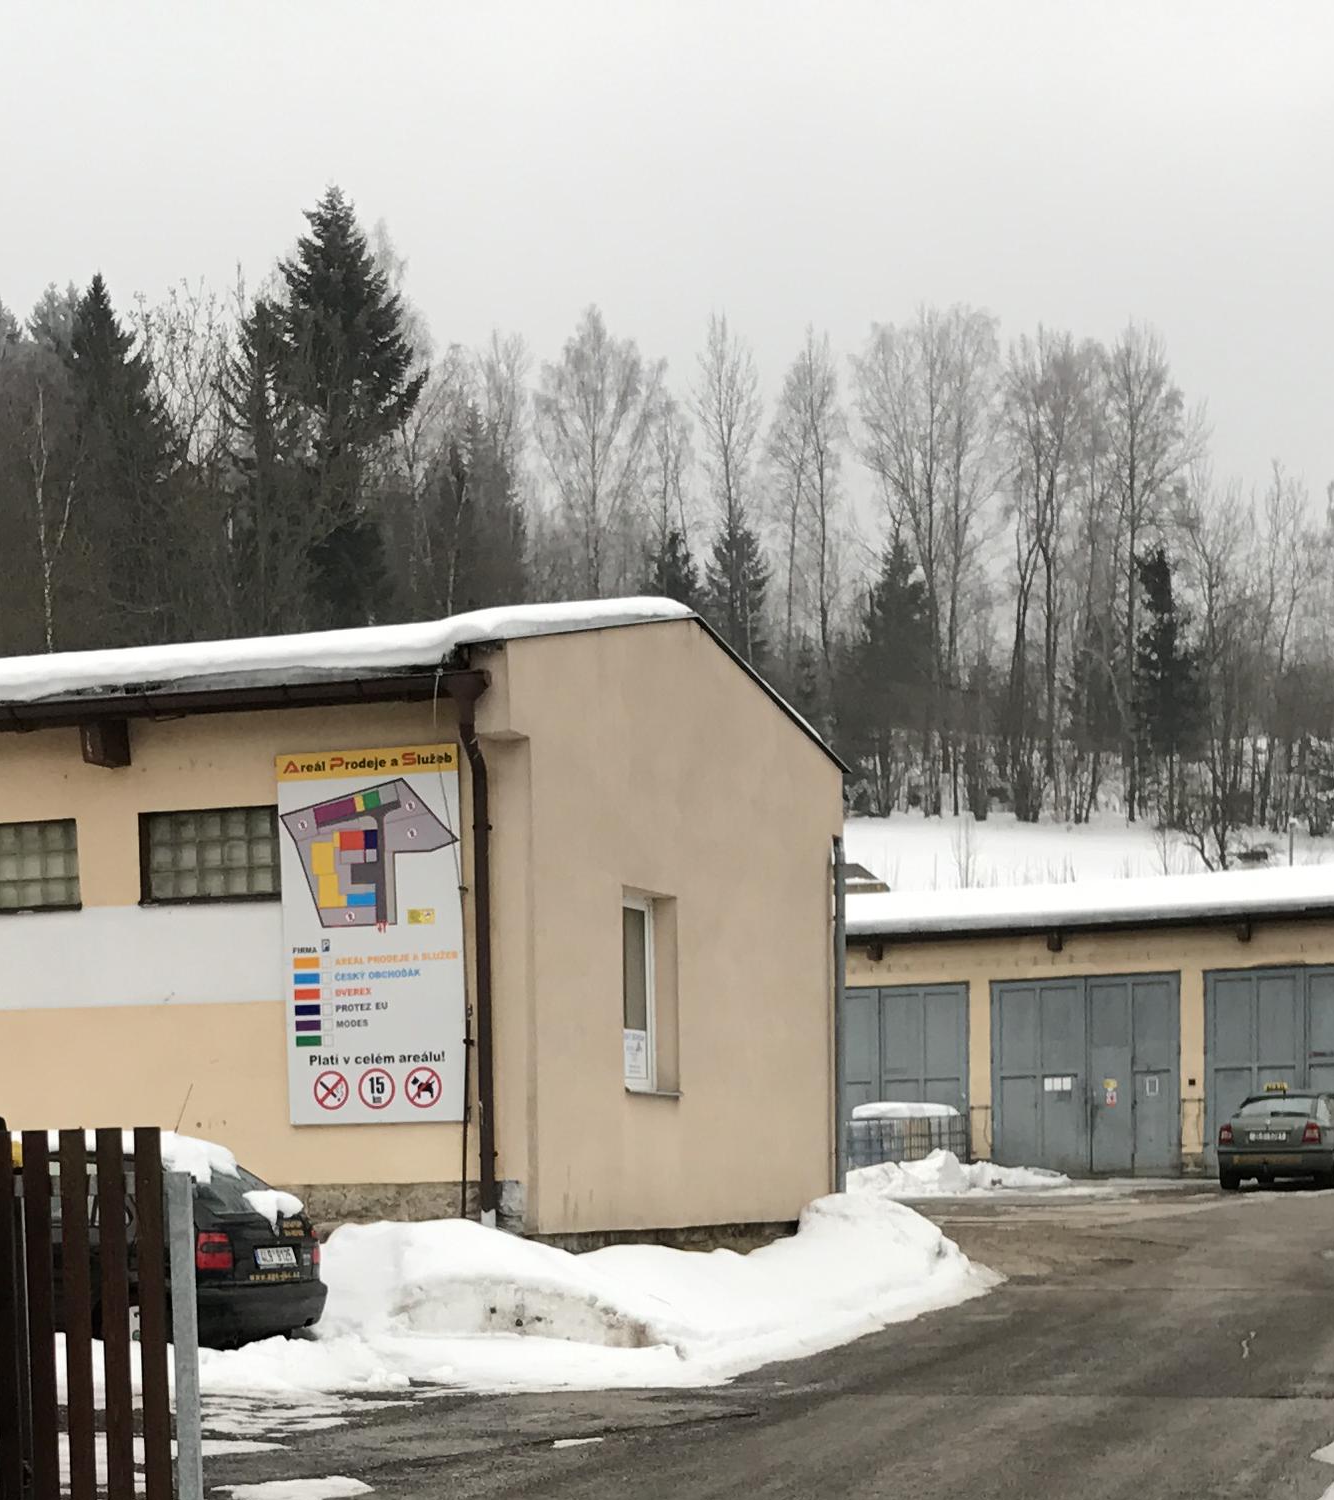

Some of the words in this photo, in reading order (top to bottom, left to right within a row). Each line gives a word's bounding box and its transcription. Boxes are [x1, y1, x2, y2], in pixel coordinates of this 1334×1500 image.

[283, 760, 326, 774] Areál
[329, 756, 387, 771] Prodeje
[390, 759, 399, 767] a
[401, 751, 453, 767] Služeb
[292, 946, 318, 954] FIRMA
[335, 1003, 372, 1013] PROTEZ
[375, 1001, 388, 1010] EU
[309, 1054, 339, 1066] Platí
[342, 1056, 351, 1065] v
[354, 1053, 396, 1065] celém
[398, 1050, 446, 1064] areálu!
[368, 1076, 385, 1095] 15
